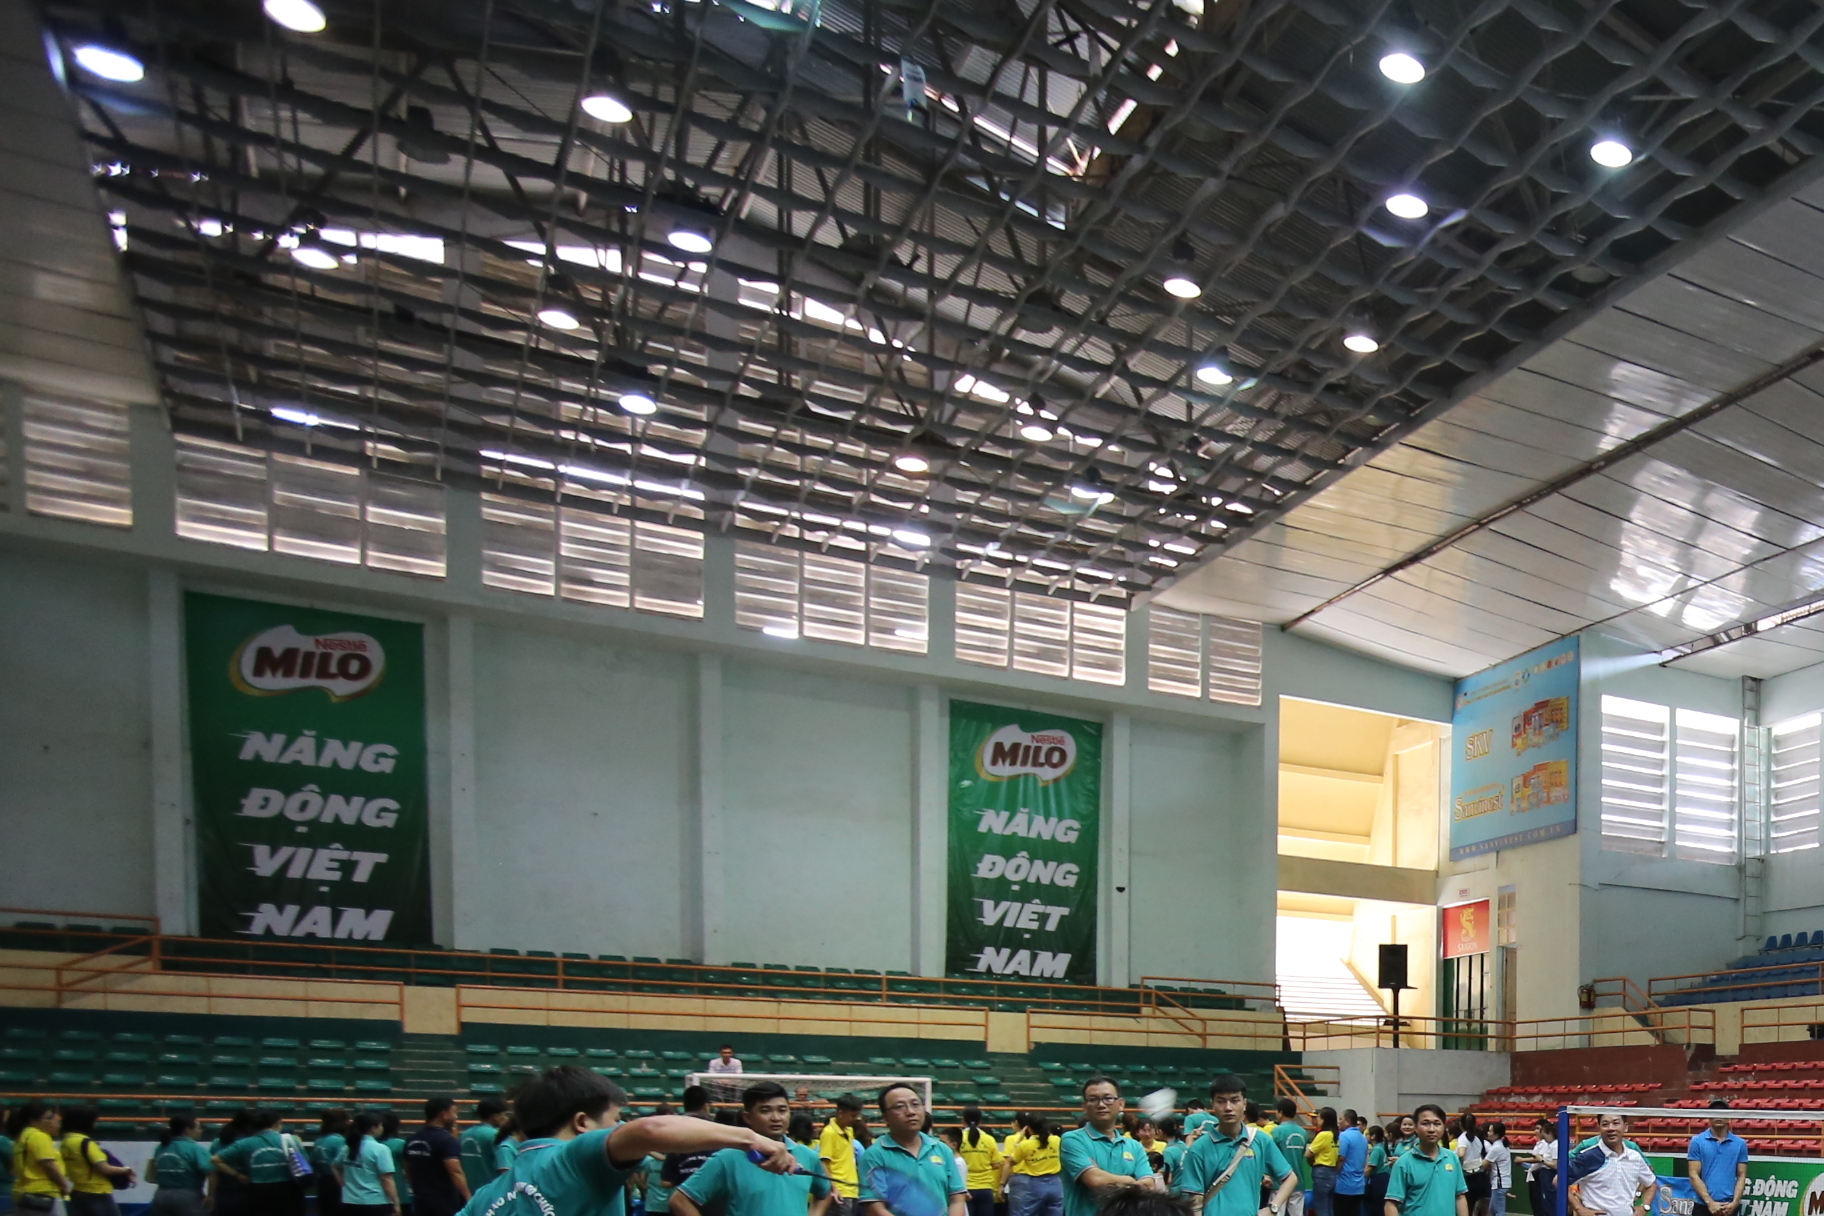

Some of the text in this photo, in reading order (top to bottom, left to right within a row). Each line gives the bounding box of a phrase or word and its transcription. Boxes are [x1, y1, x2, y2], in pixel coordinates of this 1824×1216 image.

[252, 645, 373, 681] MILO
[229, 729, 399, 774] NĂNG
[990, 742, 1067, 769] MILO
[234, 783, 401, 833] ĐỘNG
[973, 808, 1080, 844] NĂNG
[239, 842, 389, 892] VIỆT
[971, 851, 1080, 891] ĐỘNG
[234, 902, 395, 941] NAM
[973, 898, 1070, 939] VIỆT
[966, 946, 1072, 978] NAM
[1752, 1174, 1800, 1201] ĐỘNG
